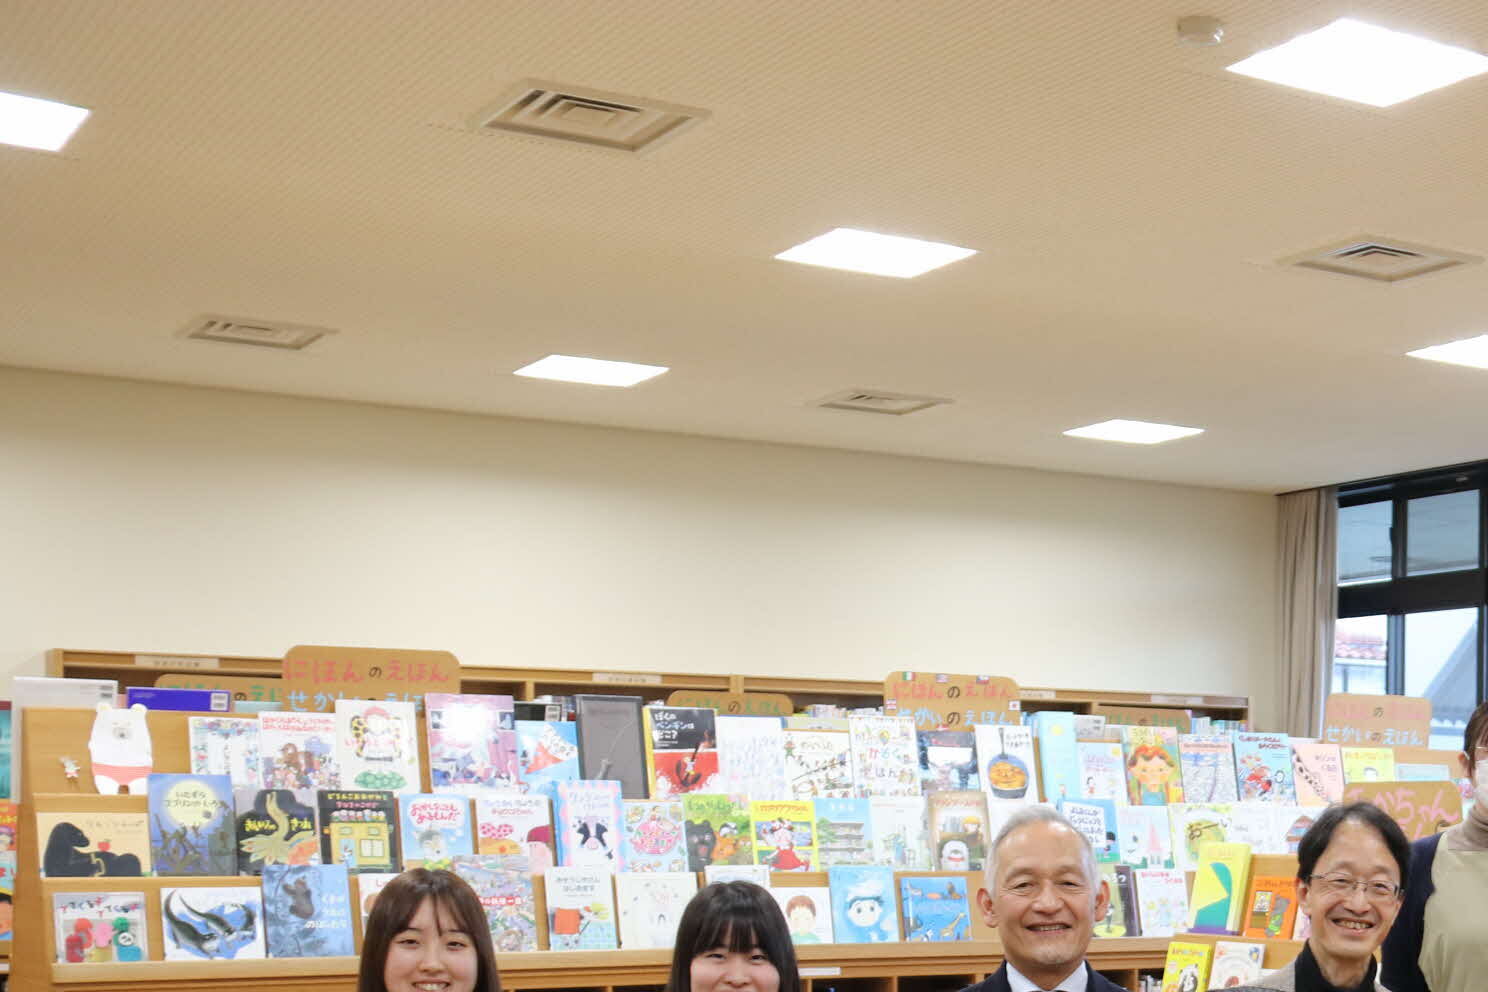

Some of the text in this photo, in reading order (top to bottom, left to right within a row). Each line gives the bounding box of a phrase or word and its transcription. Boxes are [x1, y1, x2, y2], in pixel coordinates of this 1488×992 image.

[655, 722, 695, 731] ペンギンは
